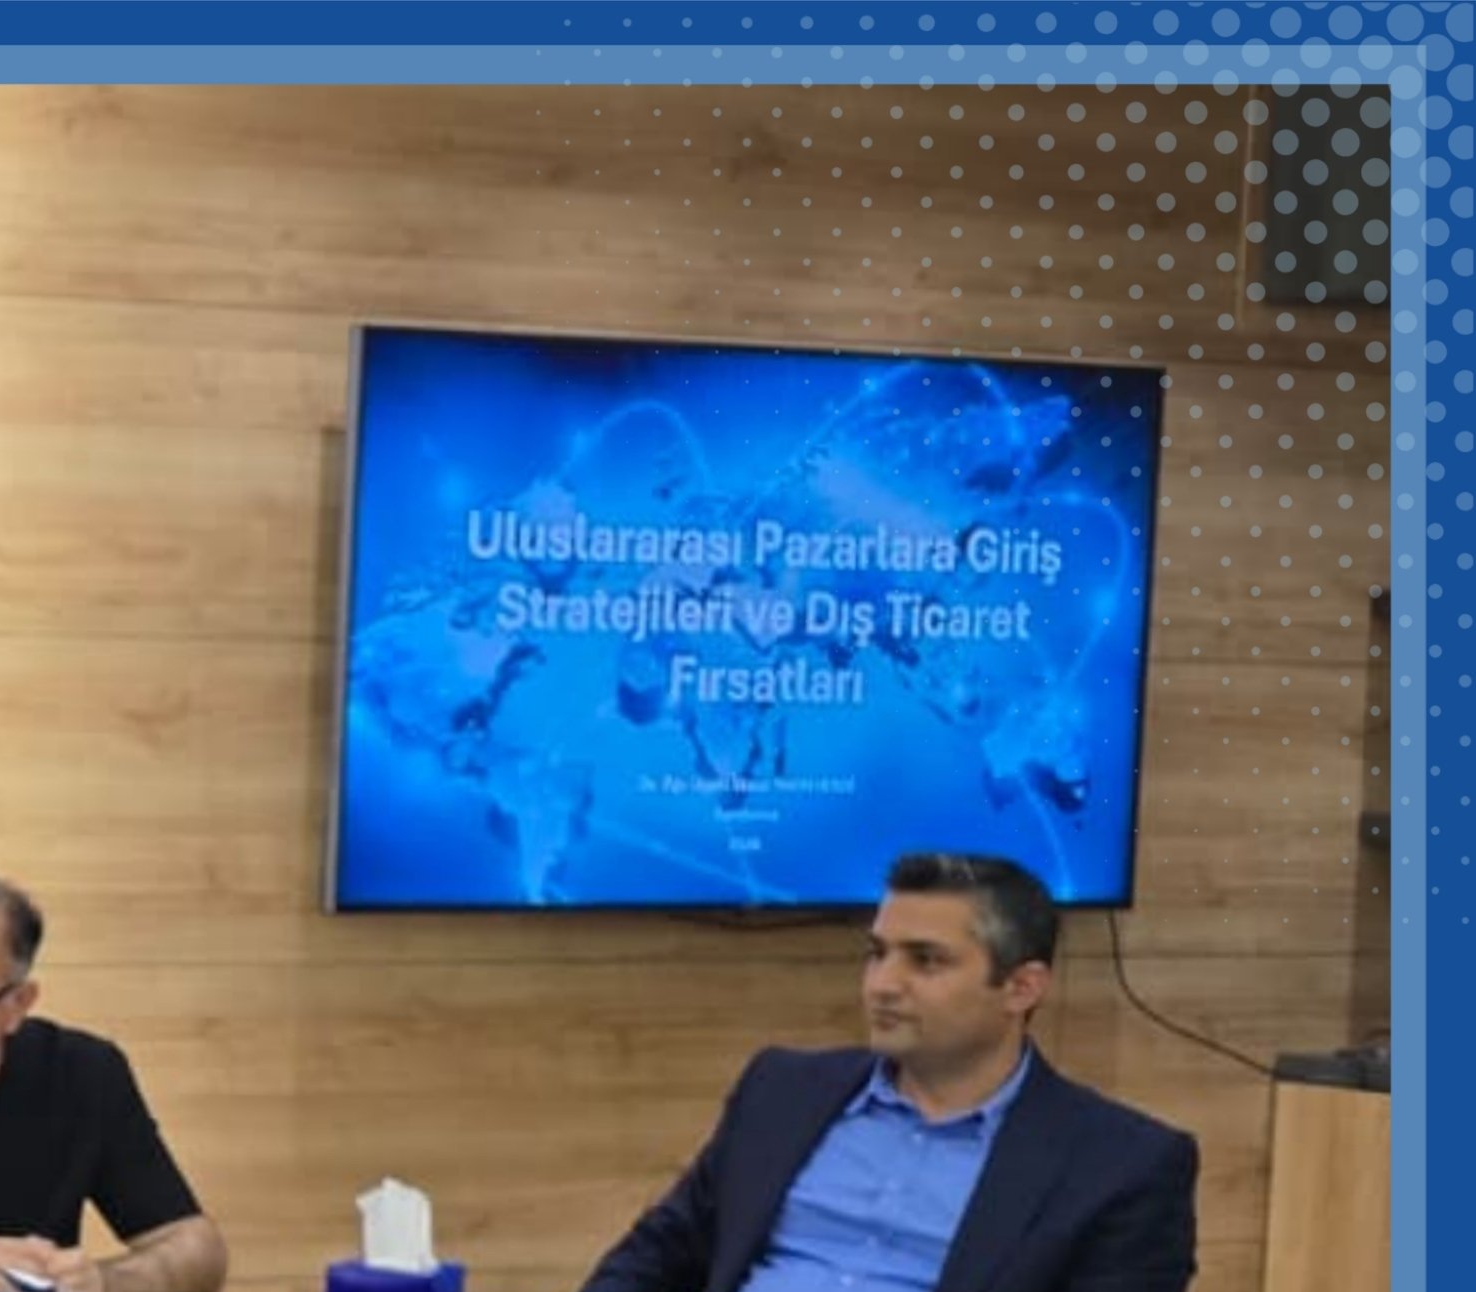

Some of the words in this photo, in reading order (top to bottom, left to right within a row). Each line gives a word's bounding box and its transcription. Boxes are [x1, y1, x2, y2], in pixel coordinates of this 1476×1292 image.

[468, 510, 744, 565] Uluslararası
[755, 520, 957, 573] Pazarlara
[965, 528, 1063, 586] Giriş
[496, 582, 733, 642] Stratejileri
[745, 602, 795, 637] ve
[805, 592, 876, 647] Dış
[889, 595, 1031, 641] Ticaret
[670, 654, 864, 703] Fırsatları
